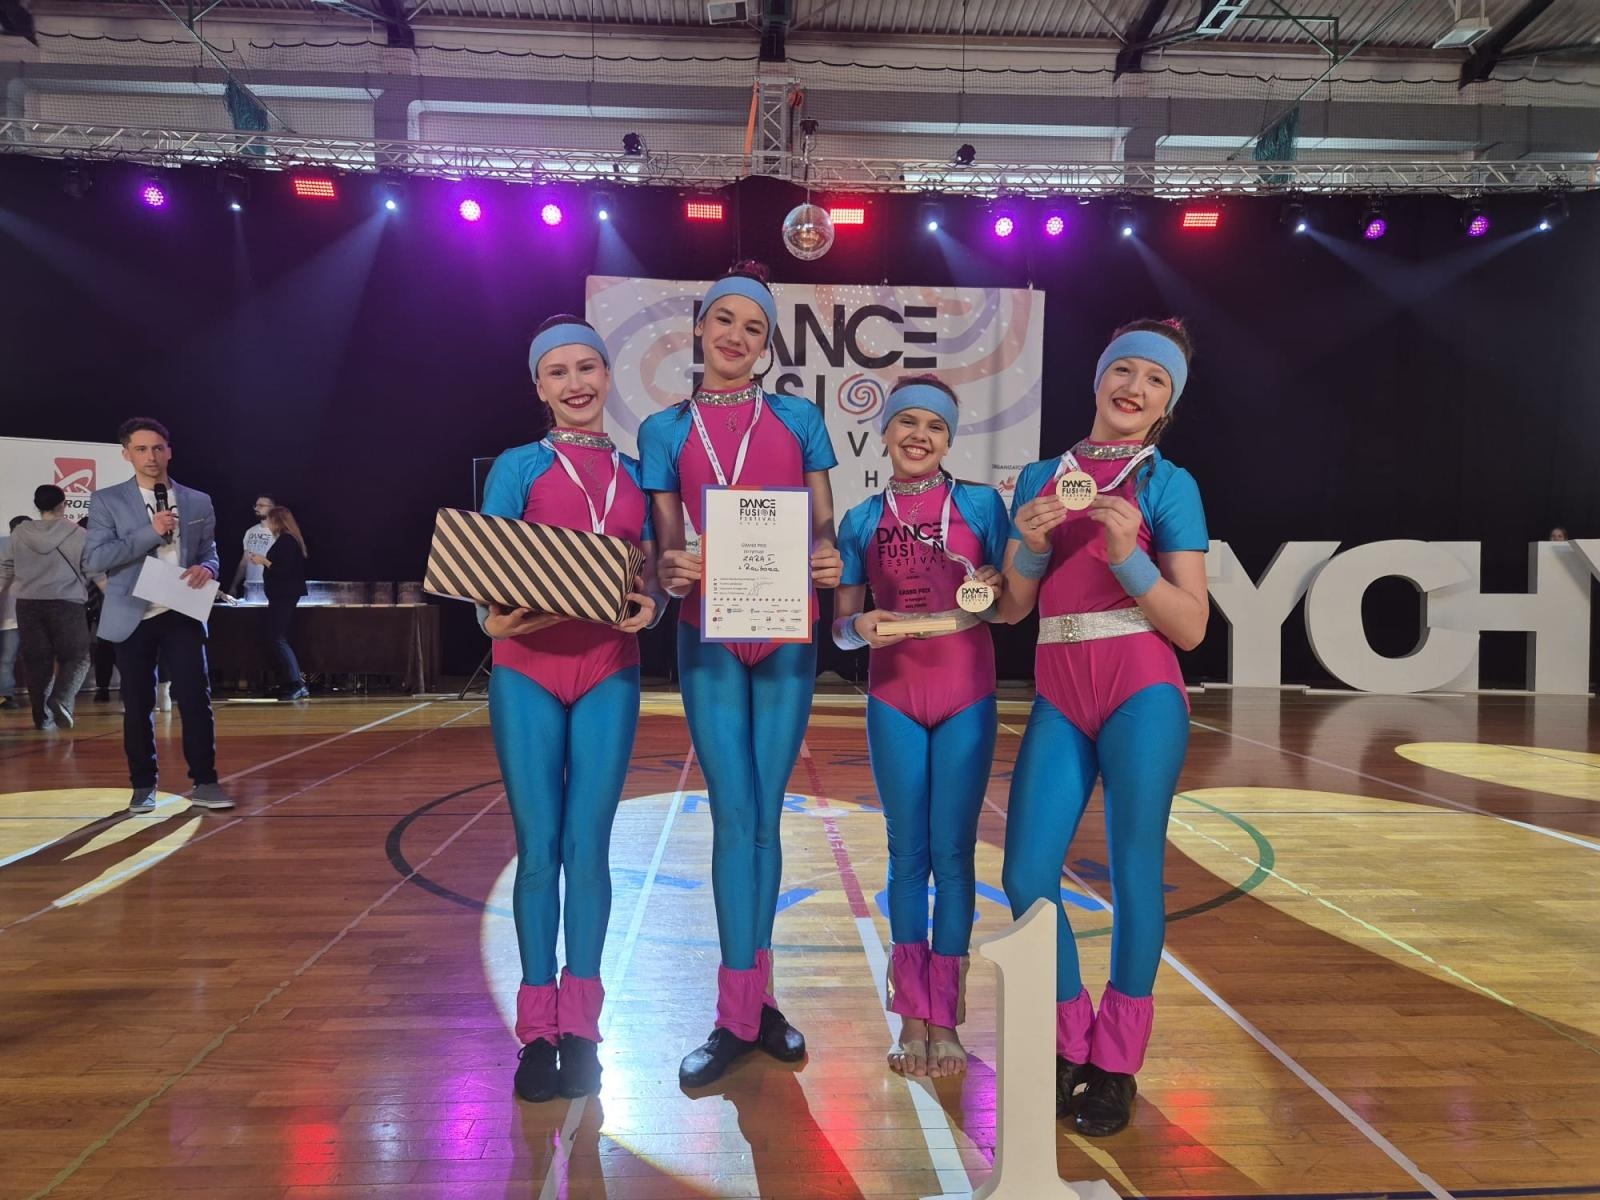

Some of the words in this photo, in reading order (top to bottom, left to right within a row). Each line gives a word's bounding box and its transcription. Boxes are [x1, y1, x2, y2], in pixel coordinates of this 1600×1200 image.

[693, 300, 937, 368] NCE
[1062, 480, 1092, 488] DANCE
[739, 498, 776, 509] DANCE
[739, 508, 776, 517] FUSION
[877, 522, 943, 544] DANCE
[878, 541, 945, 559] FUSION
[880, 554, 946, 568] FESTIVAL
[962, 587, 988, 595] DANCE
